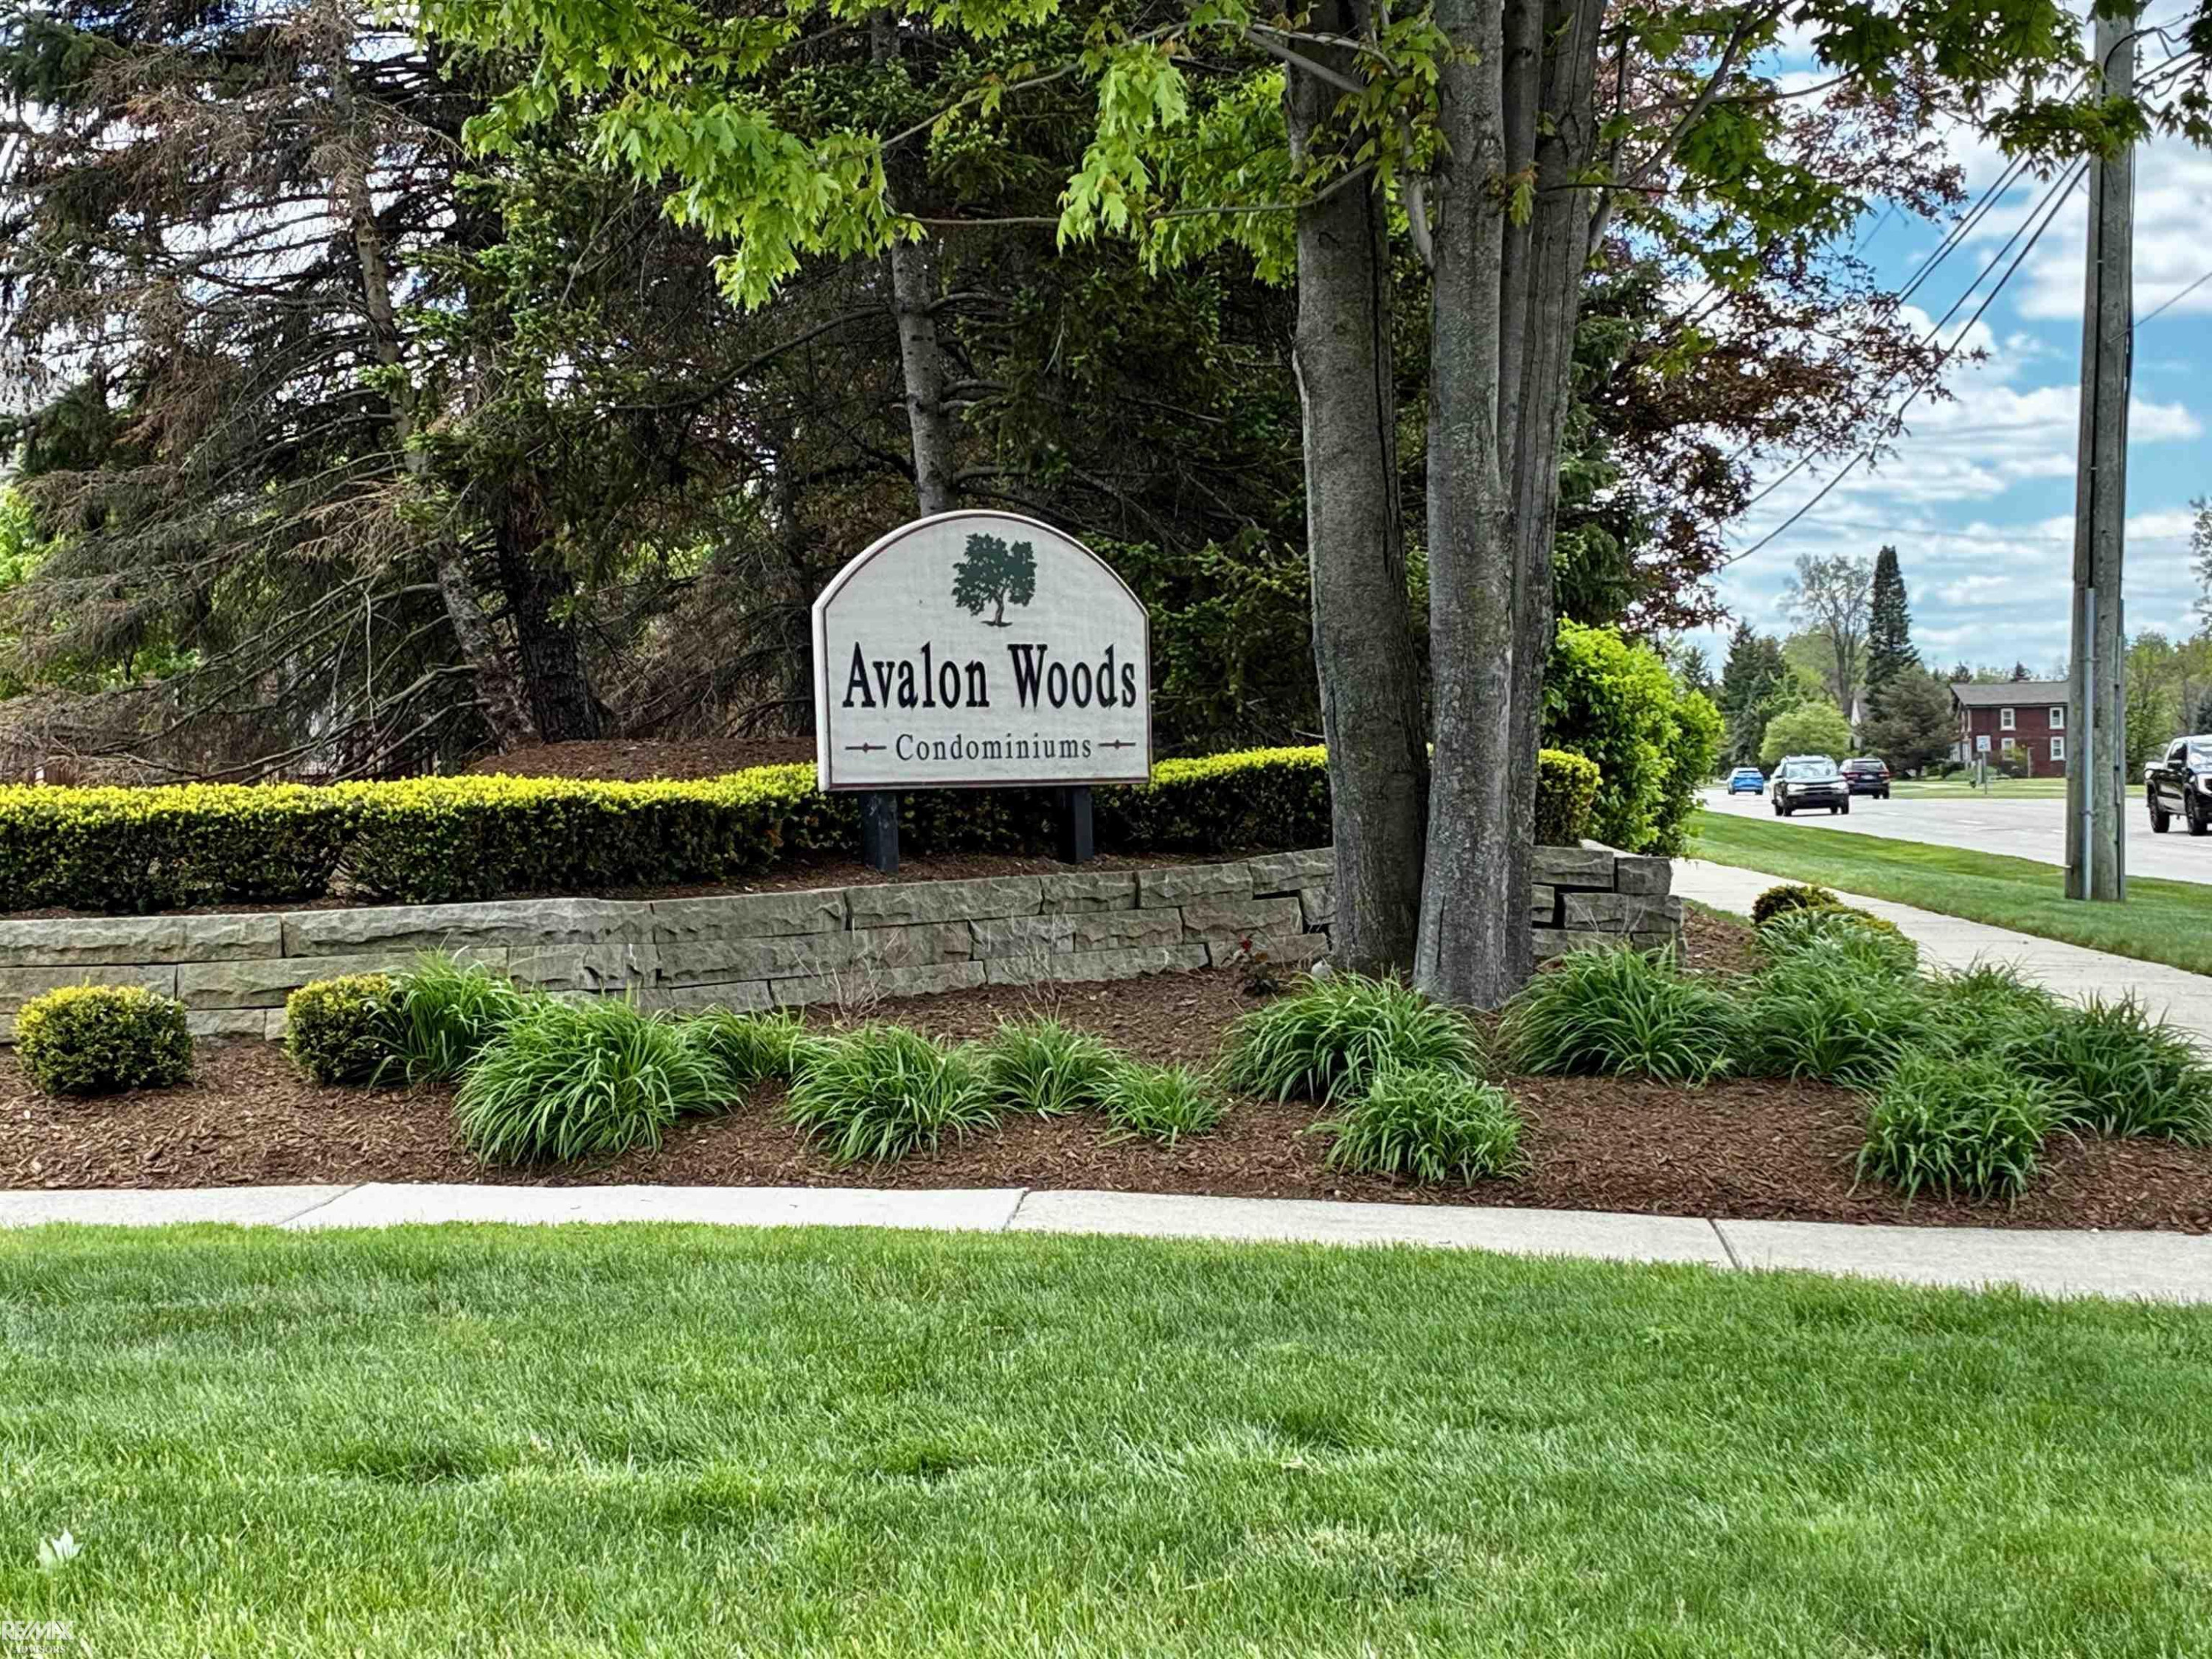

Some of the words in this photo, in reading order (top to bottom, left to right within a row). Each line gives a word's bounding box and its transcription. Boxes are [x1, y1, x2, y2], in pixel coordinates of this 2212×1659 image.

[841, 641, 990, 709] Avalon
[1007, 643, 1137, 710] Woods
[895, 733, 1092, 761] Condominiums
